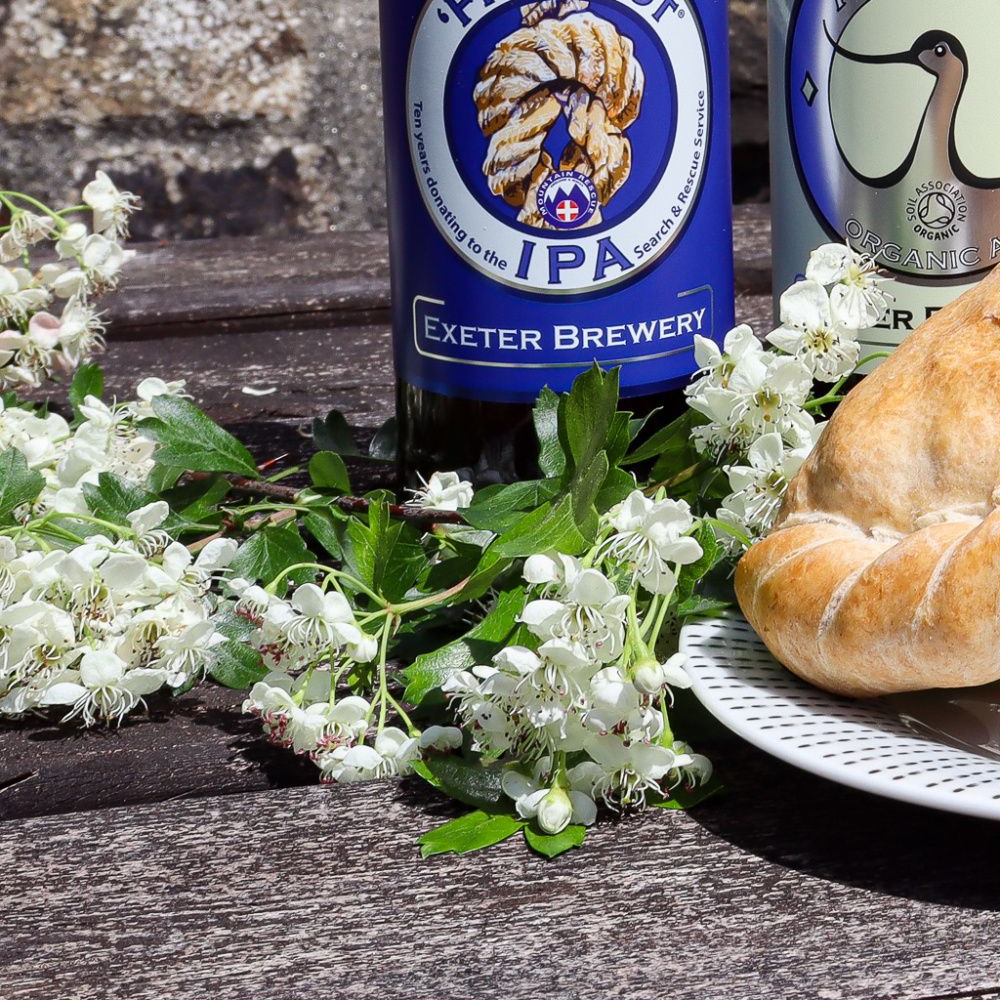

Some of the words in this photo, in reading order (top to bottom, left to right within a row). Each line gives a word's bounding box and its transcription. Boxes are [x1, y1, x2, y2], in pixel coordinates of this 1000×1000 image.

[413, 101, 423, 128] Ten
[694, 90, 705, 147] Service
[413, 131, 431, 175] years
[537, 171, 574, 216] MOUNTAIN
[578, 175, 597, 214] RESCUE
[677, 150, 701, 204] Rescue
[426, 175, 468, 242] donating
[671, 205, 683, 217] &
[906, 197, 918, 222] SOIL
[915, 180, 968, 222] ASSOCIATION
[467, 237, 482, 255] to
[633, 218, 674, 259] Search
[844, 218, 981, 271] ORGANIC
[913, 223, 960, 241] ORGANIC
[483, 249, 507, 270] the
[514, 236, 634, 285] IPA
[424, 314, 543, 350] EXETER
[553, 308, 706, 350] BREWERY
